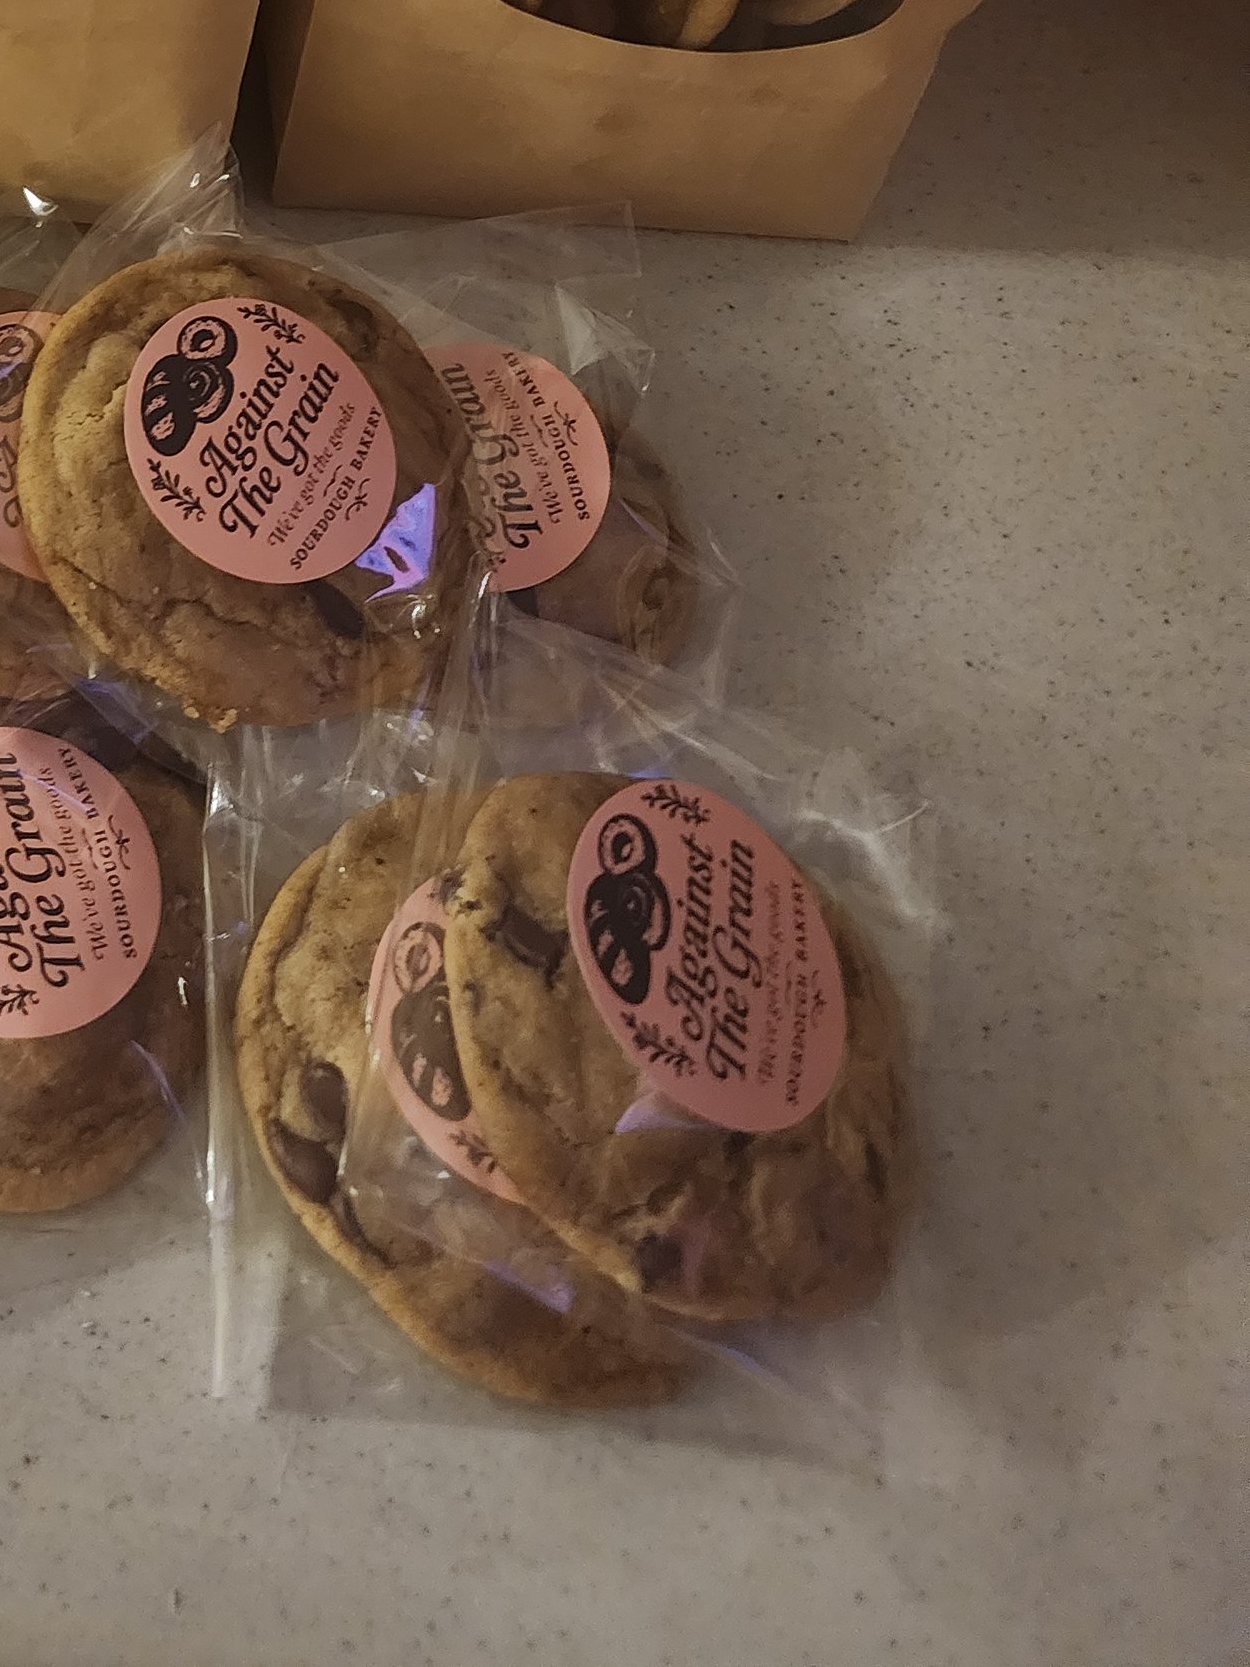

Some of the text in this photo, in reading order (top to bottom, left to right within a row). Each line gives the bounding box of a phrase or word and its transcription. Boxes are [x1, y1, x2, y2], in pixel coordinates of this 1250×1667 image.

[200, 344, 295, 499] Against
[483, 368, 520, 412] goods
[509, 414, 530, 439] the
[218, 362, 340, 539] The Grain
[289, 406, 384, 571] SOURDOUGH BAKERY
[301, 471, 320, 506] got
[313, 445, 333, 475] the
[330, 402, 356, 453] goods
[522, 441, 549, 467] got
[541, 413, 591, 521] SOURDOUGH
[491, 469, 544, 549] The
[57, 825, 79, 855] the
[68, 860, 97, 892] got
[30, 892, 86, 988] The
[93, 829, 138, 959] SOURDOUGH
[664, 833, 715, 1042] Against
[706, 838, 763, 1081] The Grain
